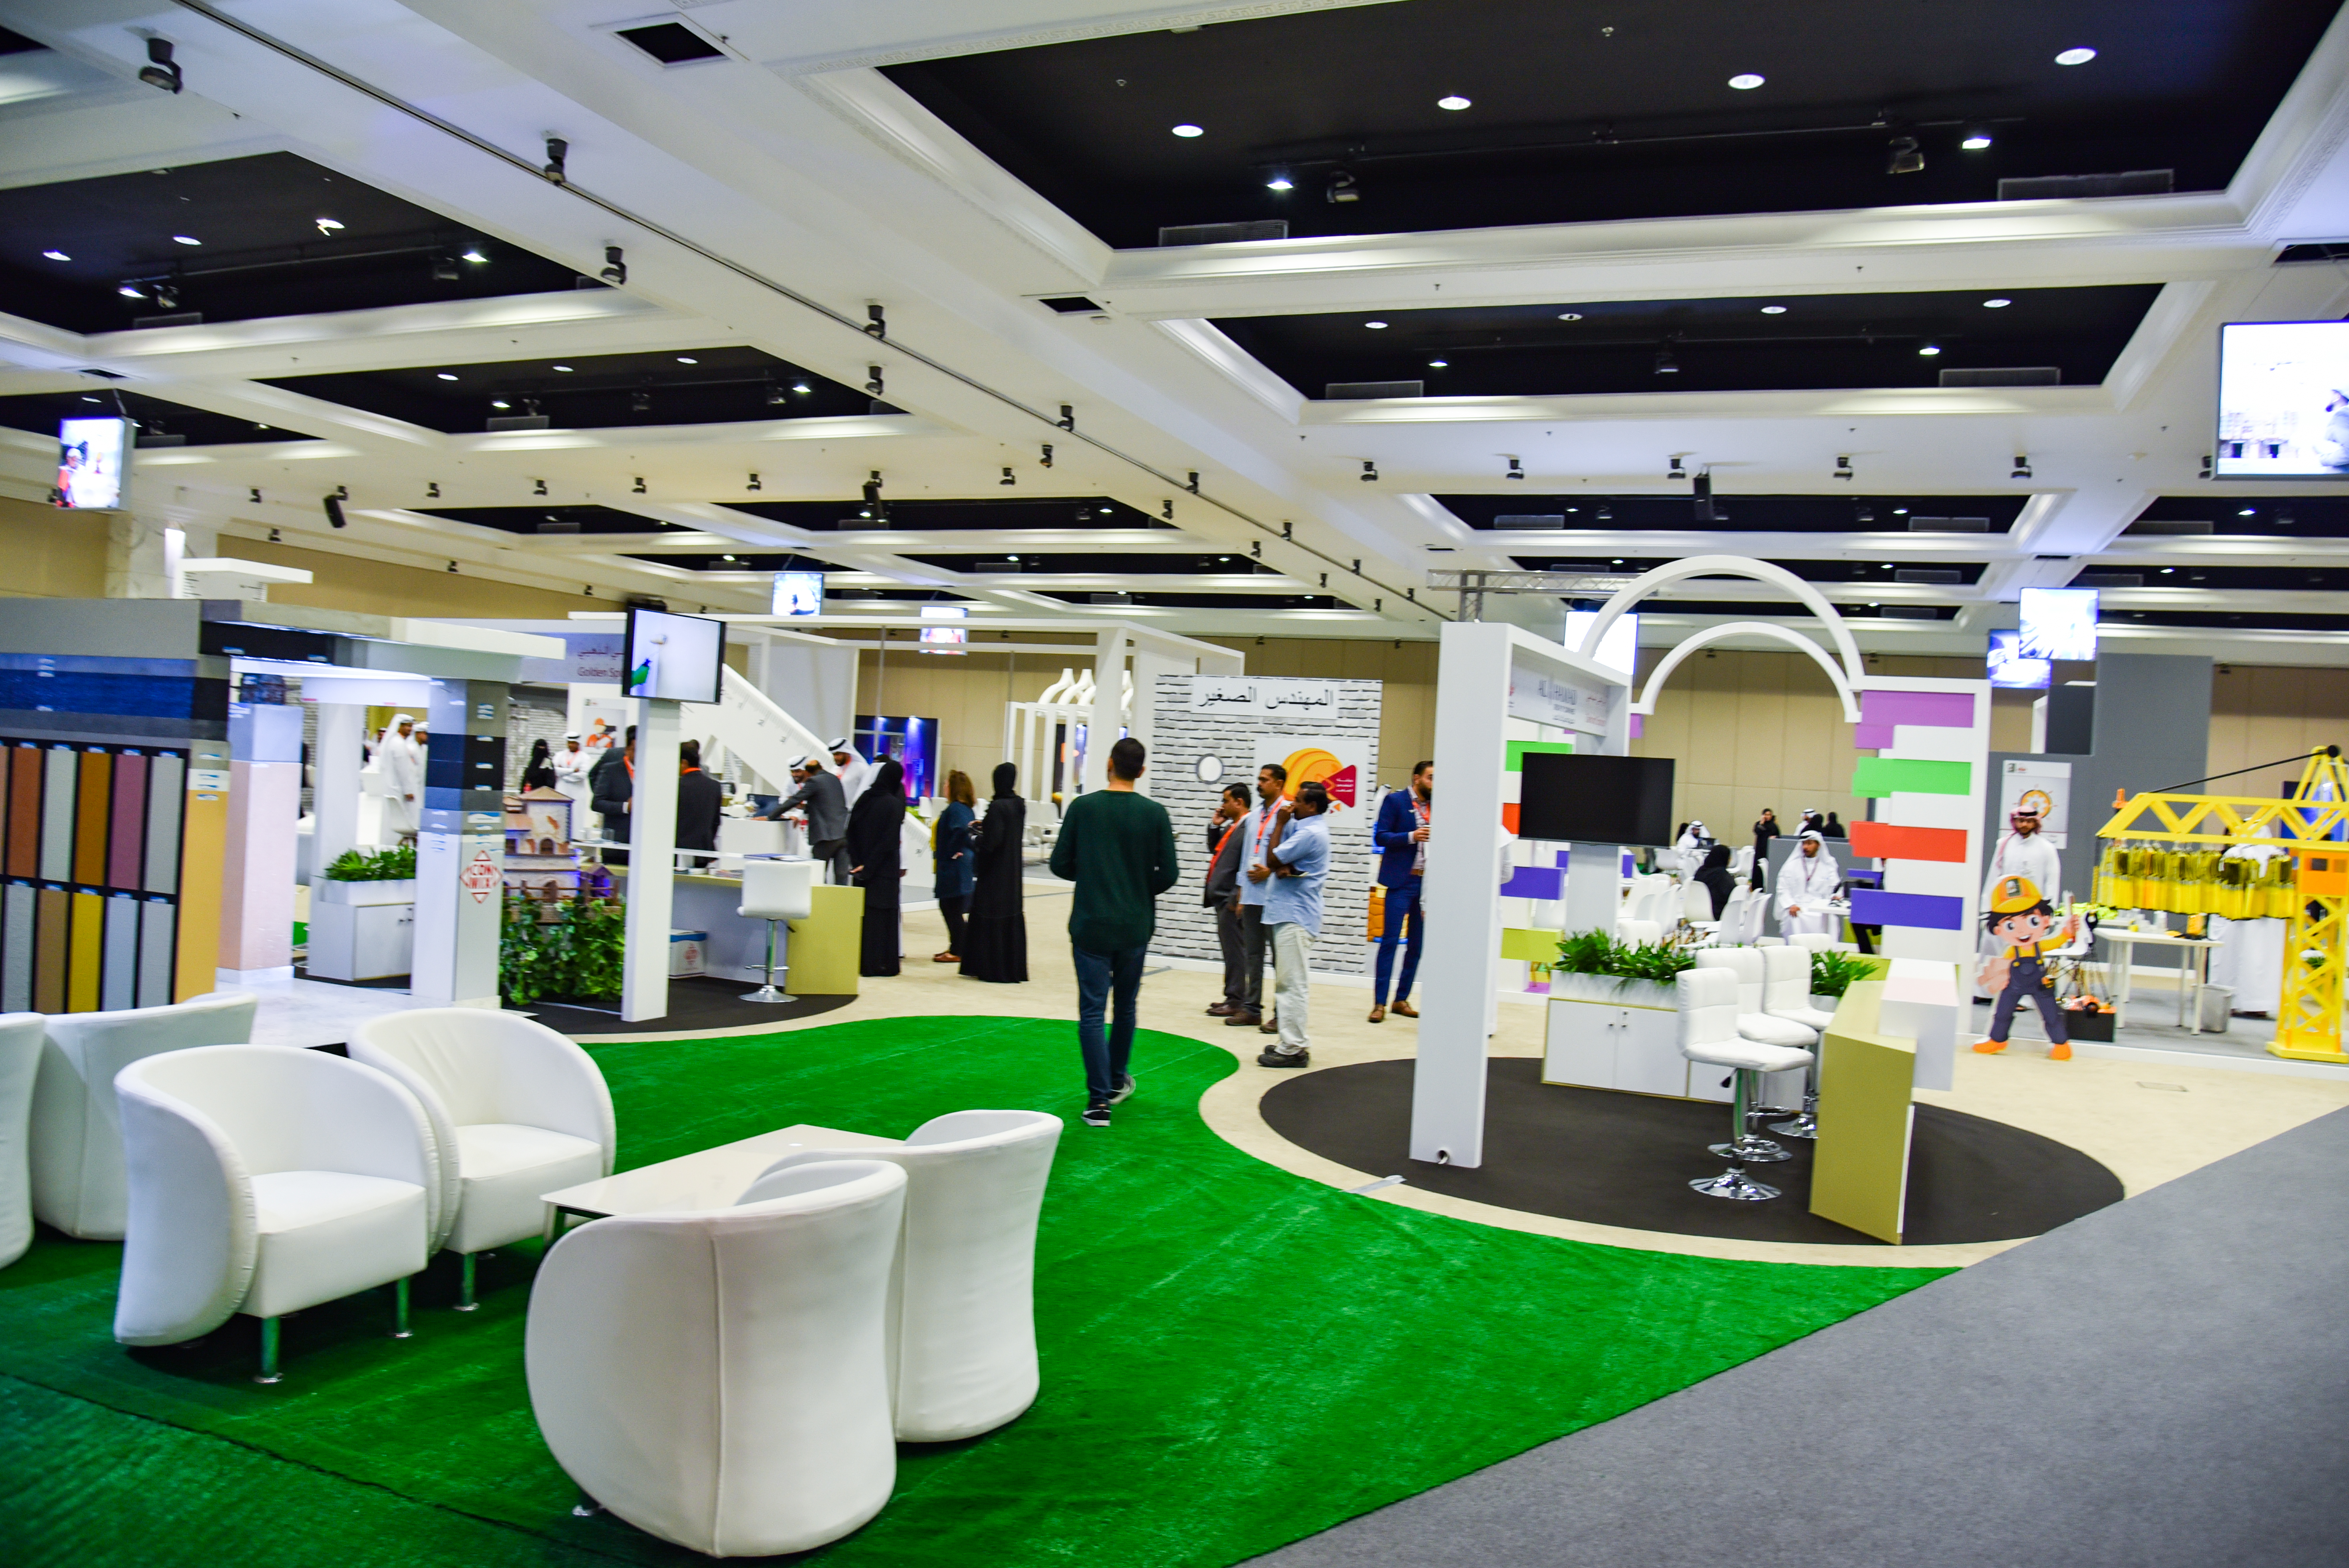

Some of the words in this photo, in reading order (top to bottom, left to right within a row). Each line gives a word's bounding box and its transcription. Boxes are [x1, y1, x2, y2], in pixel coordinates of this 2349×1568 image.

[578, 666, 607, 676] Golden
[1196, 686, 1257, 707] الصغير
[1265, 688, 1334, 711] المهندس
[470, 864, 493, 876] CON
